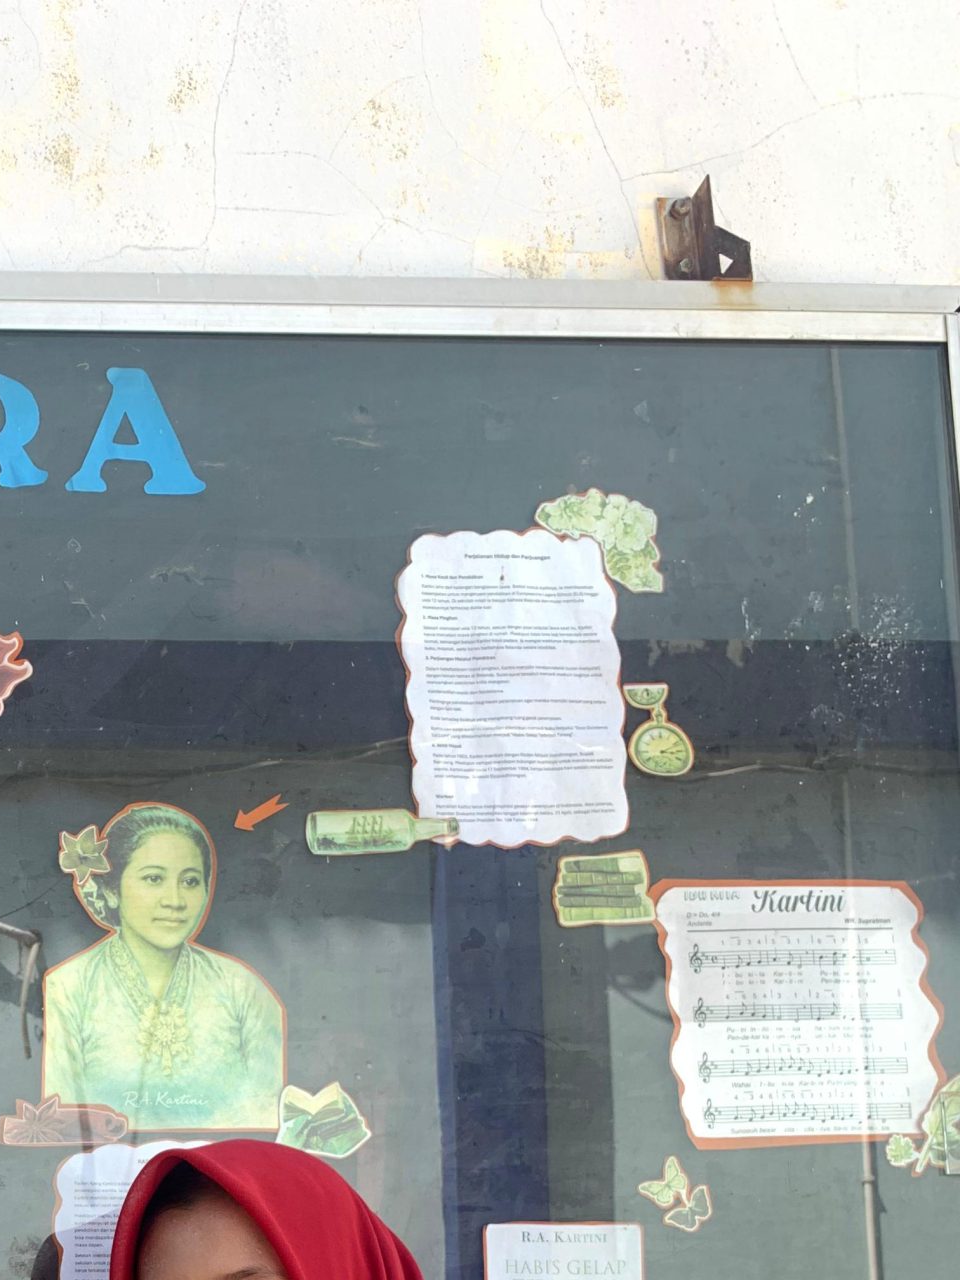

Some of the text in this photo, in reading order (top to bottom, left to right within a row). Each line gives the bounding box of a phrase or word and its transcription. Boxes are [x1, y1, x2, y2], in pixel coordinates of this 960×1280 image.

[751, 890, 846, 913] Kartini
[505, 1259, 627, 1275] HABIS GELAP
